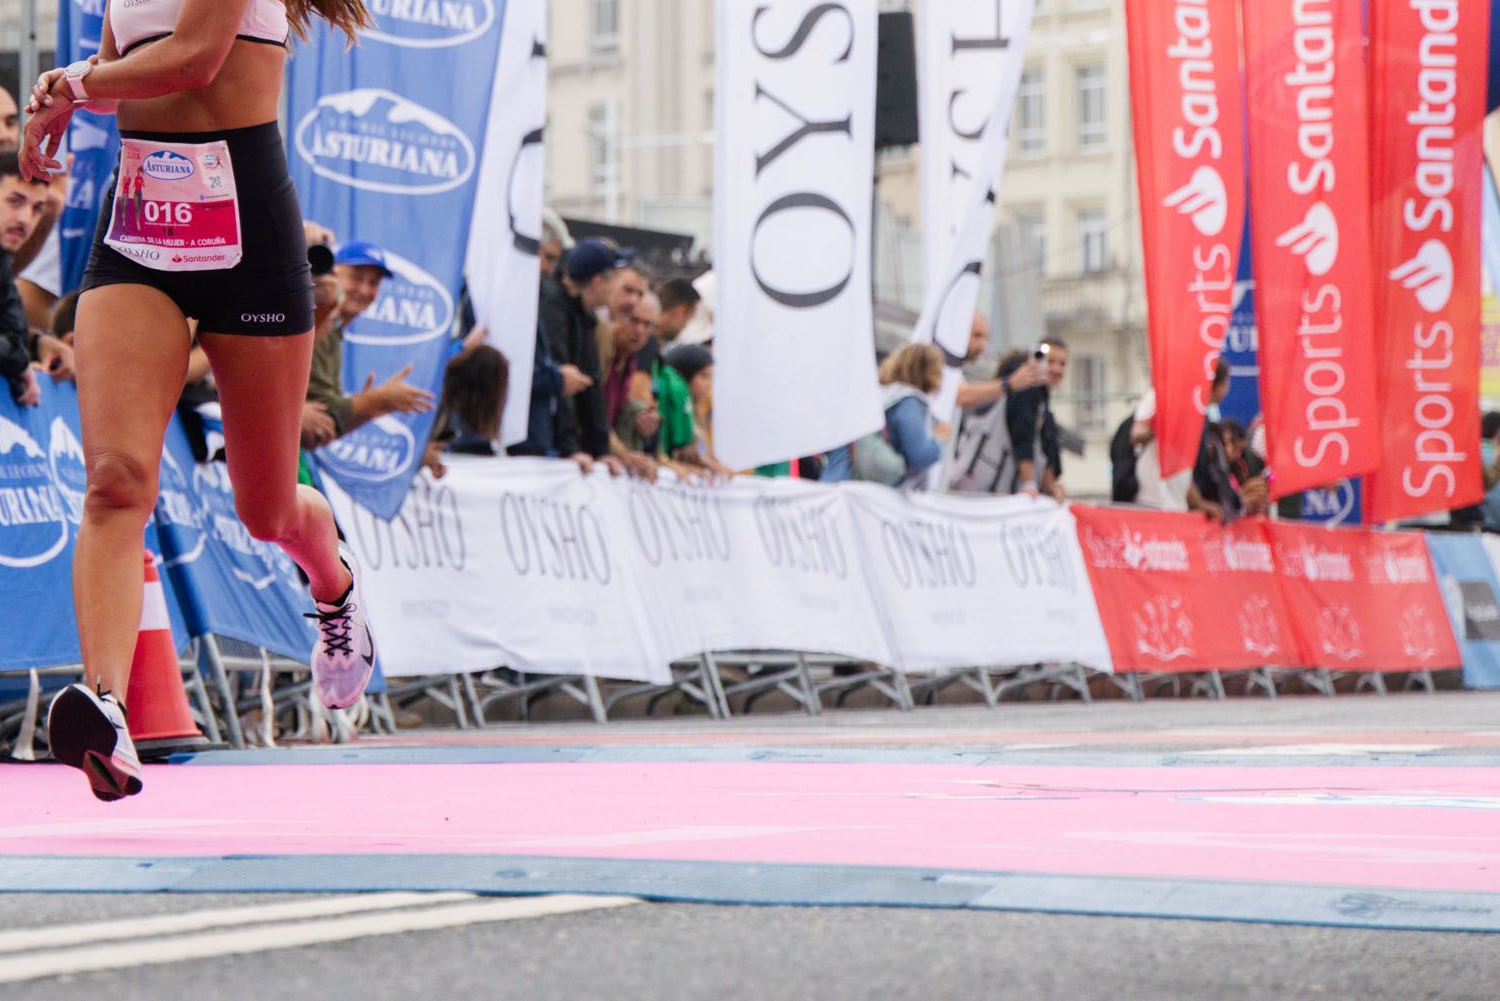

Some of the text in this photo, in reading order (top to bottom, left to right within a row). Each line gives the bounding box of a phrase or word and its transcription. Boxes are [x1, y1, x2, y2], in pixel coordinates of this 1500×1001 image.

[145, 160, 192, 175] ASTURIANA
[144, 201, 193, 224] 016
[162, 238, 185, 247] MUJER
[197, 236, 227, 246] CORUÑA
[183, 254, 226, 263] Santander
[240, 312, 286, 324] OYSHO
[1294, 283, 1360, 468] Sports
[1402, 320, 1467, 498] Sports
[502, 491, 612, 587] OYSHO
